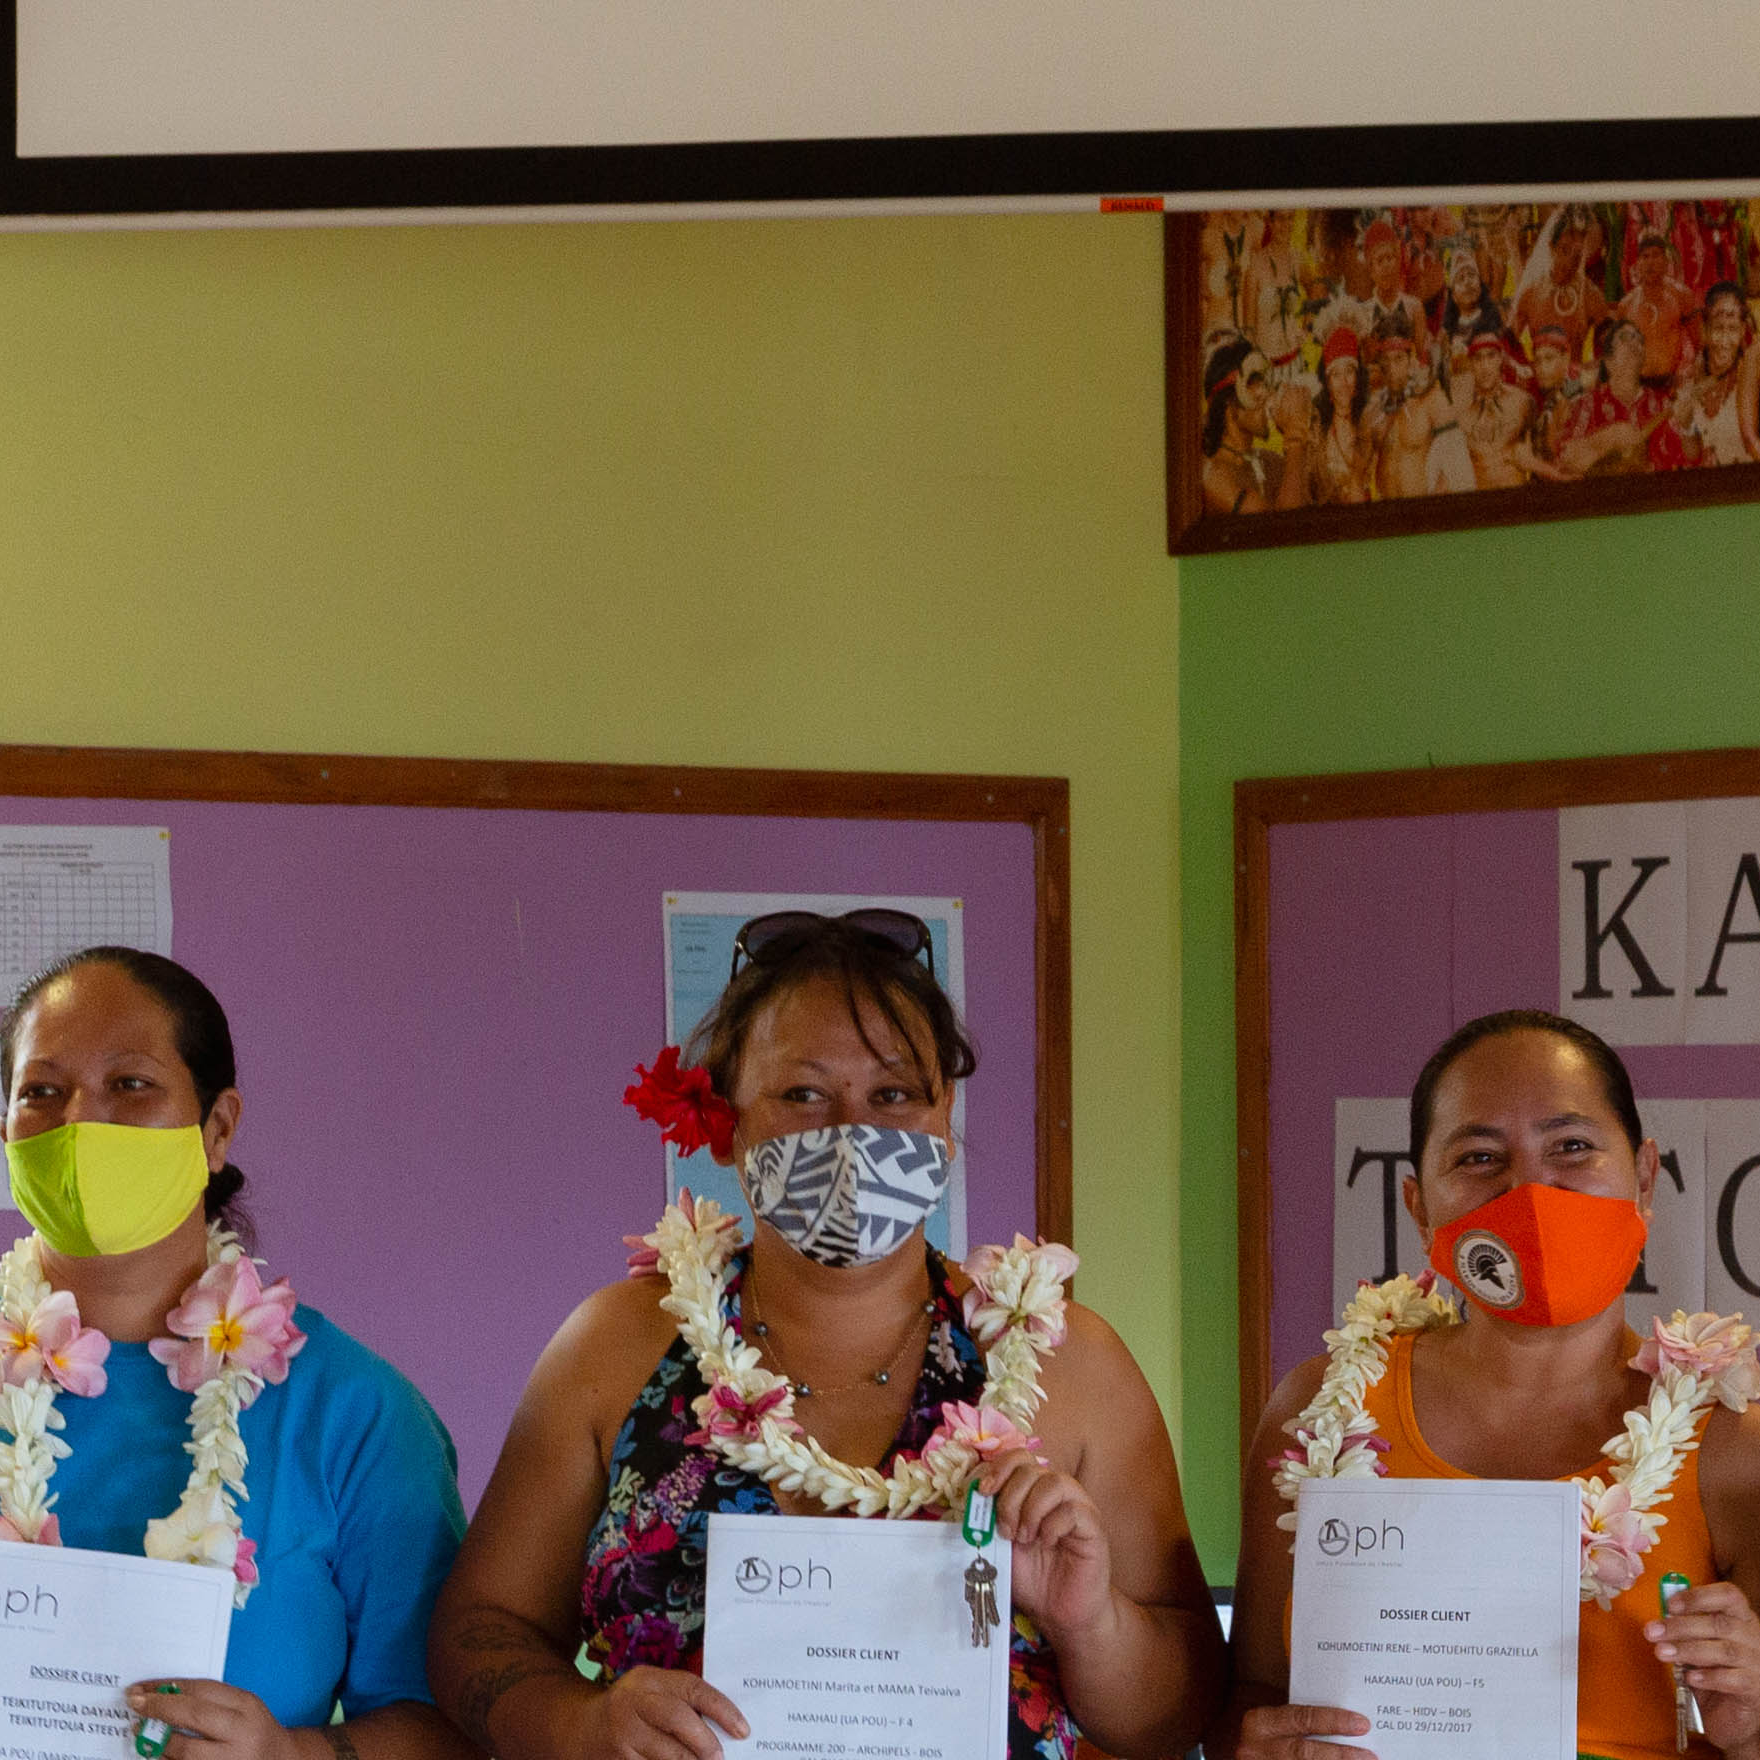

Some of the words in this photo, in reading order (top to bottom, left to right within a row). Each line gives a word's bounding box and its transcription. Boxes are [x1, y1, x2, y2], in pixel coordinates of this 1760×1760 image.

[1379, 1608, 1428, 1621] DOSSIER
[1431, 1610, 1471, 1622] CLIENT
[806, 1646, 857, 1659] DOSSIER
[860, 1648, 900, 1661] CLIENT
[1317, 1641, 1384, 1653] KOHUMOETINI
[1386, 1643, 1412, 1654] RENE
[1422, 1644, 1484, 1656] MOTUEHITU
[1486, 1646, 1539, 1658] GRAZIELLA
[30, 1664, 80, 1682] DOSSIER
[81, 1672, 121, 1688] CLIENT
[1364, 1675, 1413, 1686] HAKAHAU
[1415, 1676, 1434, 1688] (UA
[1436, 1677, 1462, 1689] POU)
[1377, 1705, 1402, 1716] FARE
[1413, 1706, 1438, 1717] HIDV
[1448, 1707, 1472, 1719] BOIS
[1376, 1720, 1395, 1730] CAL
[1397, 1720, 1412, 1731] DU
[1415, 1721, 1472, 1733] 29/12/2017
[756, 1740, 824, 1754] PROGRAMME
[827, 1743, 846, 1754] 200
[856, 1745, 911, 1757] ARCHIPELS
[919, 1748, 943, 1759] BOIS
